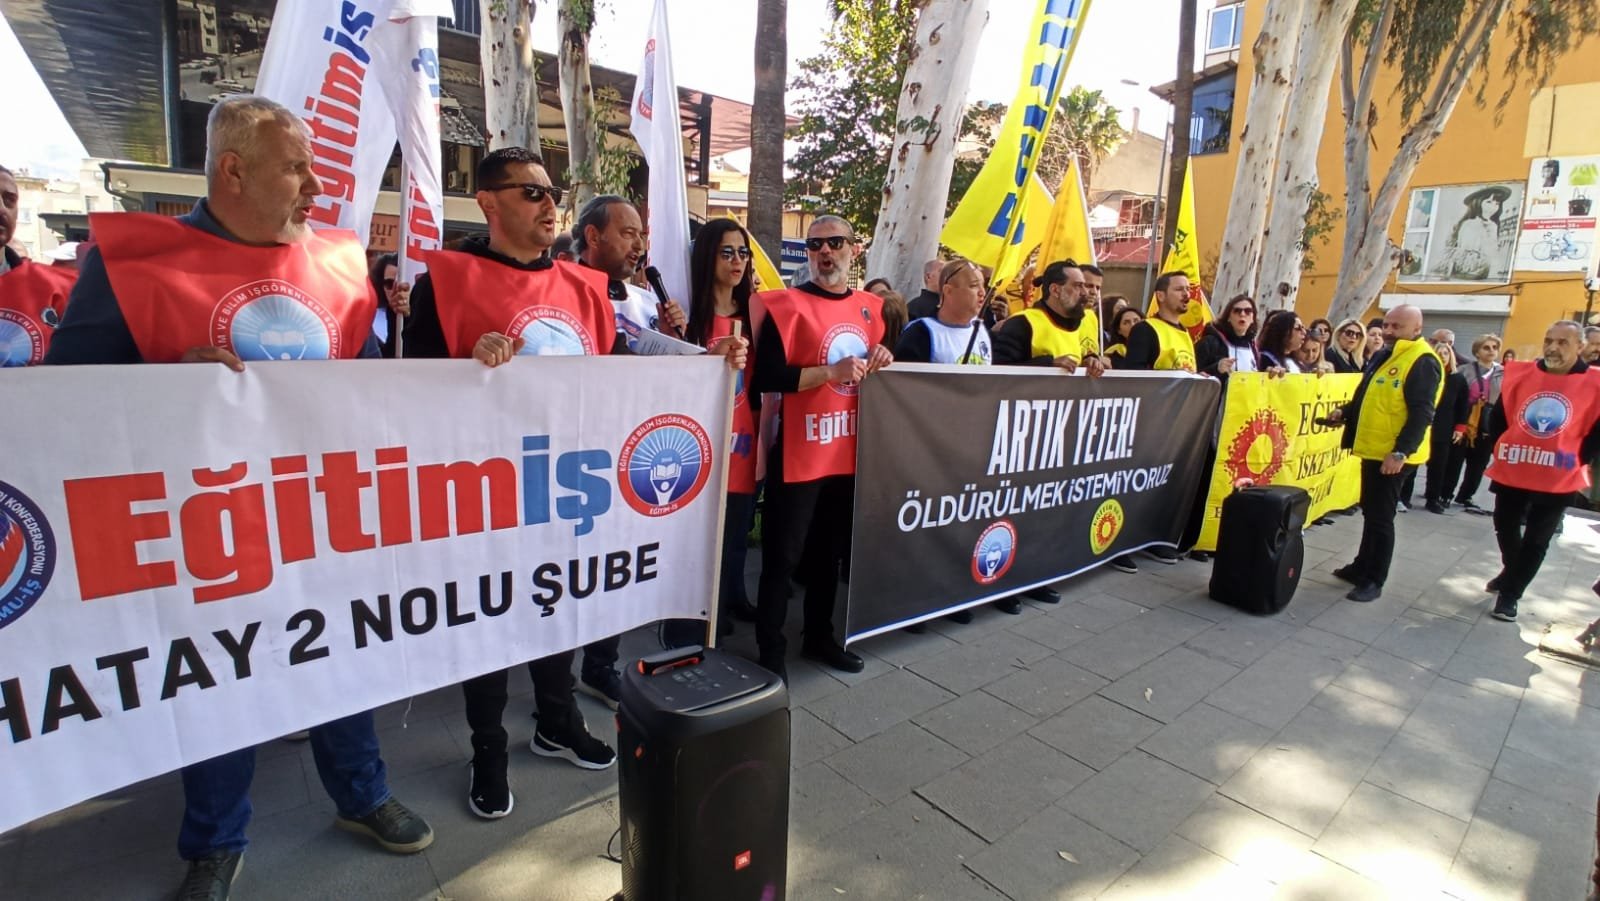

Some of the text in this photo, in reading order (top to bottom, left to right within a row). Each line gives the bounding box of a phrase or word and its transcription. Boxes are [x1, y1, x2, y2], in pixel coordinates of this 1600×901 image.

[217, 316, 228, 330] VE
[222, 292, 248, 316] BİLİM
[249, 282, 325, 315] İŞGÖRENLERİ
[629, 436, 638, 446] VE
[636, 421, 655, 437] BİLİM
[987, 397, 1141, 476] ARTIK YETER!
[63, 435, 612, 604] Eğitimiş
[898, 480, 1069, 533] ÖLDÜRÜLMEK
[6, 497, 46, 575] KONFEDERASYONU
[286, 608, 330, 666] 2
[350, 570, 513, 649] NOLU
[532, 542, 660, 618] ŞUBE
